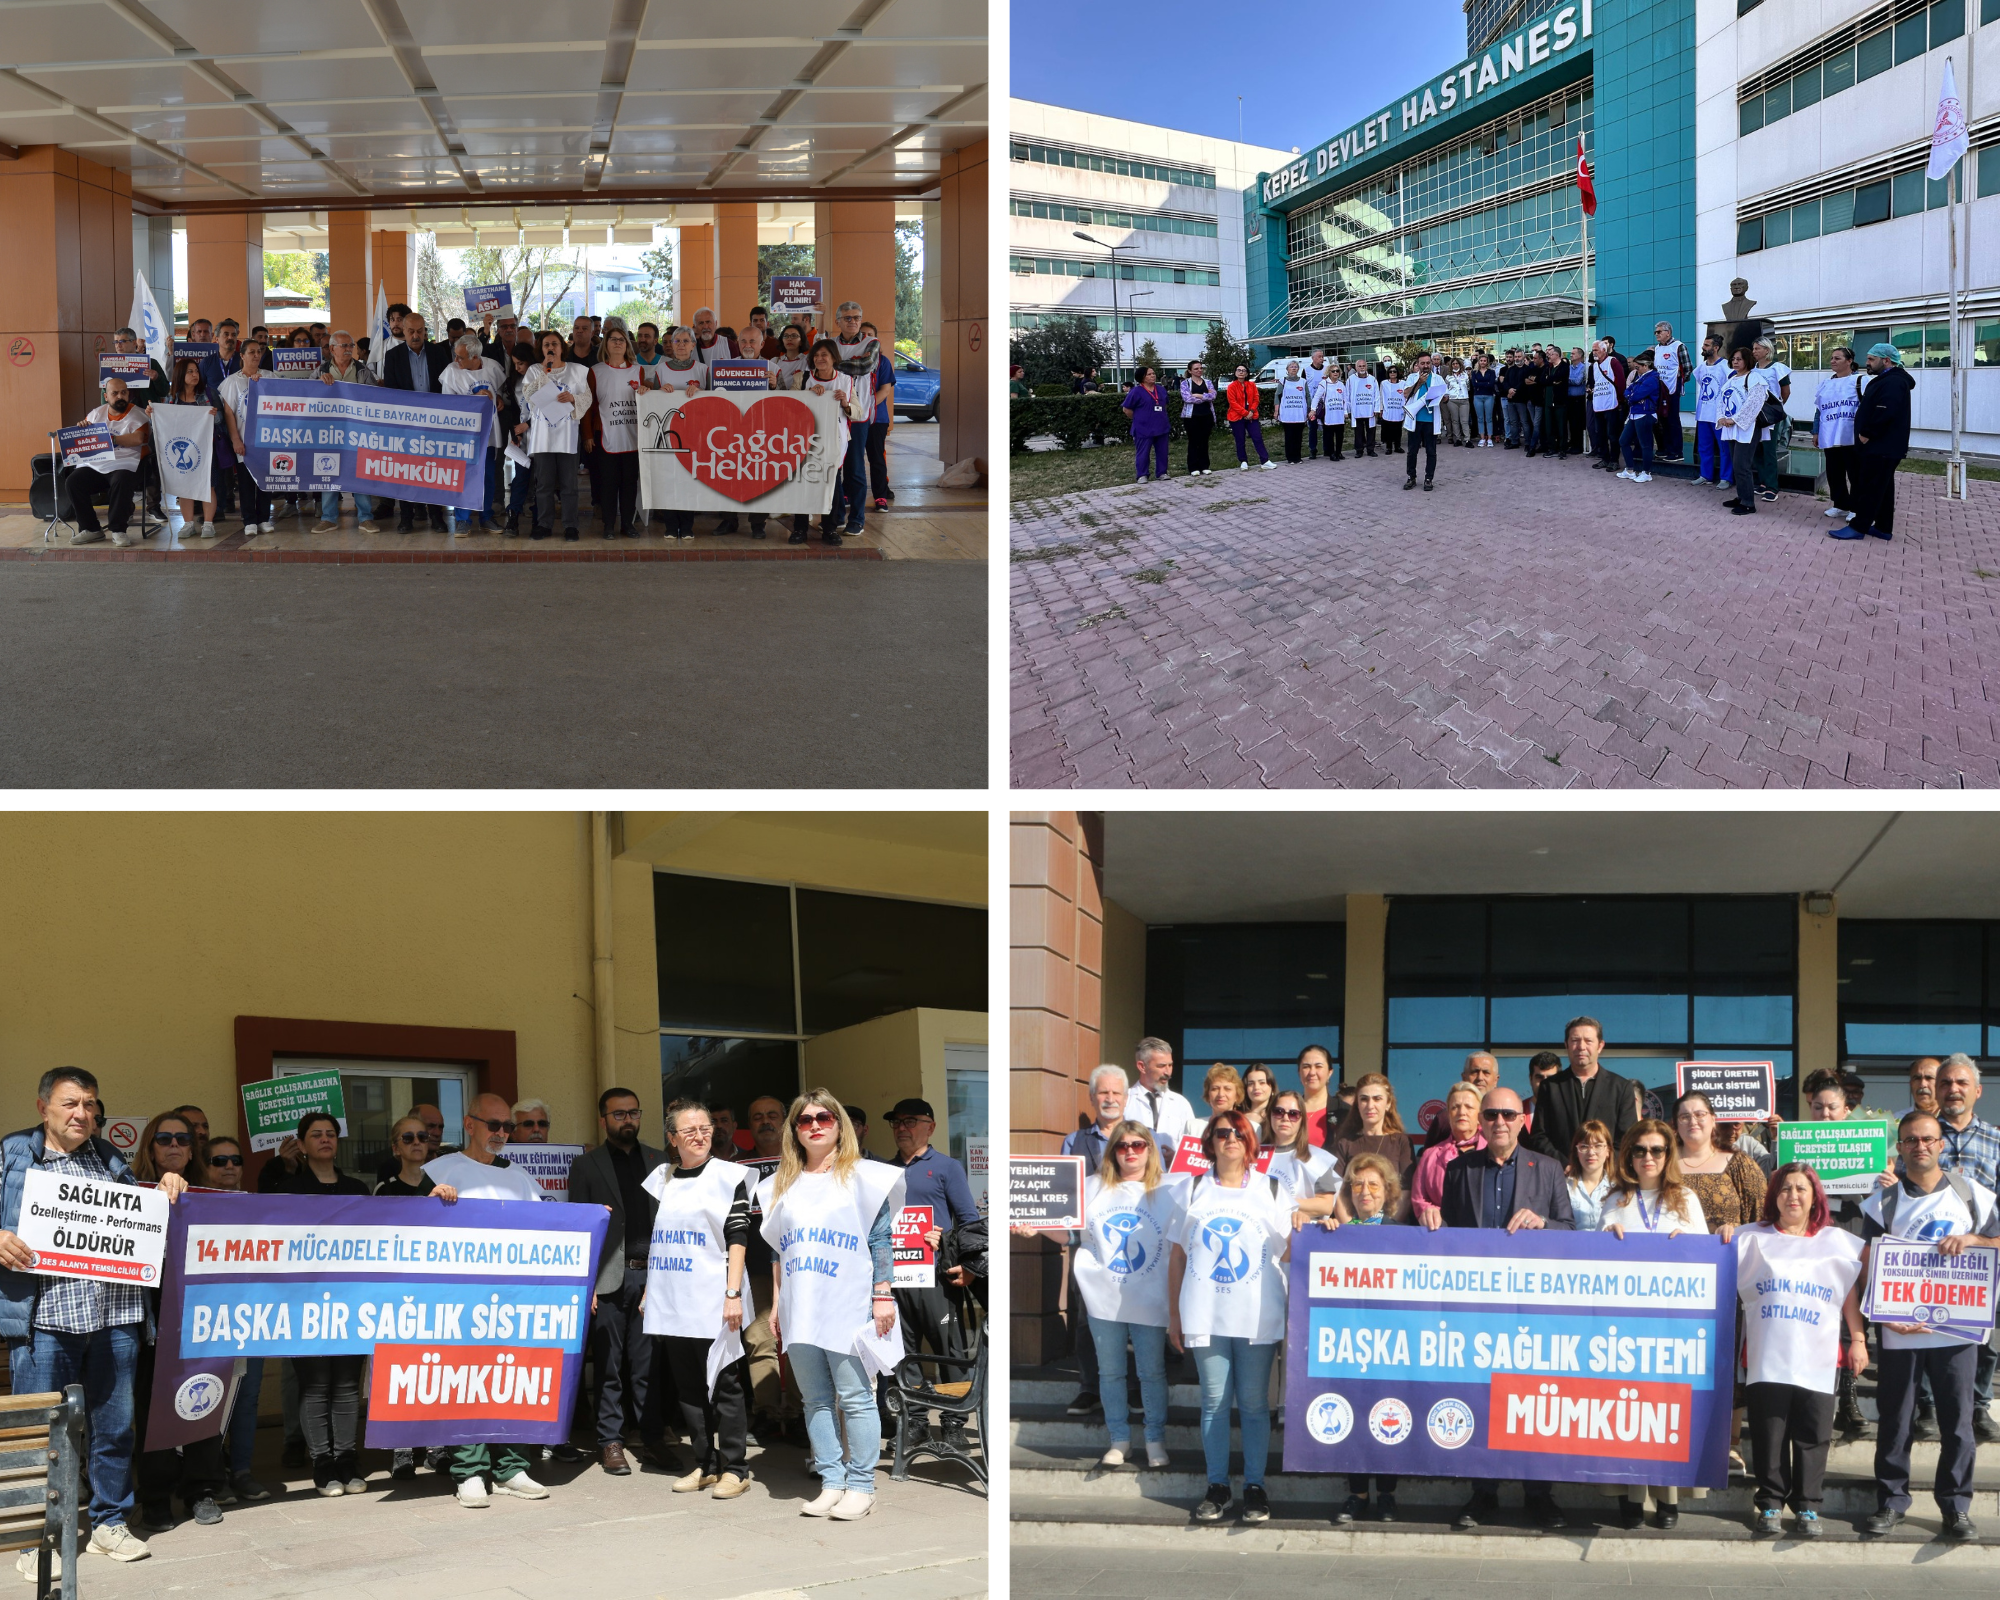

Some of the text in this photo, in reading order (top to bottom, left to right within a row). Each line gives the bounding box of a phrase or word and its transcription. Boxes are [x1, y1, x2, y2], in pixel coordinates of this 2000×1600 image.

[1263, 158, 1309, 203] KEPEZ
[1316, 111, 1391, 176] DEVLET
[478, 300, 499, 312] ASM
[276, 350, 318, 361] VERGİDE
[278, 362, 318, 371] ADALET
[716, 368, 765, 378] GÜVENCELİ İŞ
[609, 400, 637, 408] ANTALY
[262, 401, 476, 428] 14 MART MÜCADELE İLE BAYRAM OLACAK!
[260, 424, 475, 460] BAŞKA BİR SAĞLIK SİSTEMİ
[706, 426, 824, 462] Çağdaş
[364, 456, 460, 486] MÜMKÜN!
[692, 451, 834, 484] Hekimler
[1691, 1069, 1759, 1079] ŞİDDET ÜRETEN
[245, 1077, 338, 1101] SAĞLIK ÇALIŞANLARINA
[1692, 1080, 1760, 1090] SAĞLIK SİSTEMİ
[258, 1092, 328, 1111] ÜCRETSİZ ULAŞIM
[1708, 1094, 1755, 1110] EĞİŞSİN
[1781, 1128, 1885, 1142] SAĞLIK ÇALIŞANLARINA
[530, 1152, 561, 1164] EĞİTİMİ
[1794, 1142, 1872, 1155] ÜCRETSİZ ULAŞIM
[538, 1166, 567, 1176] AYRILAN
[761, 1165, 769, 1174] İŞ
[1869, 1157, 1874, 1168] !
[1027, 1181, 1050, 1191] AÇIK
[58, 1182, 142, 1212] SAĞLIKTA
[1042, 1194, 1068, 1204] KREŞ
[30, 1202, 97, 1224] Özelleştirme
[106, 1214, 162, 1234] Performans
[53, 1226, 135, 1256] ÖLDÜRÜR
[666, 1230, 706, 1247] HAKTIR
[808, 1227, 858, 1252] HAKTIR
[196, 1233, 581, 1266] 14 MART MÜCADELE İLE BAYRAM OLACAK!
[42, 1257, 140, 1276] SES ALANYA TEMSİLCİLİĞİ
[1884, 1250, 1989, 1270] EK ÖDEME DEĞİL
[1112, 1276, 1127, 1284] SES
[1319, 1263, 1706, 1298] 14 MART MÜCADELE İLE BAYRAM OLACAK!
[1883, 1268, 1988, 1281] YOKSULLUK SINIRI ÜZERİNDE
[1756, 1276, 1833, 1302] SAĞLIK HAKTIR
[1882, 1279, 1987, 1307] TEK ÖDEME
[192, 1291, 579, 1350] BAŞKA BİR SAĞLIK SİSTEMİ
[1761, 1305, 1820, 1326] SATILAMAZ
[1318, 1320, 1706, 1375] BAŞKA BİR SAĞLIK SİSTEMİ
[388, 1352, 552, 1406] MÜMKÜN!
[1506, 1383, 1680, 1444] MÜMKÜN!
